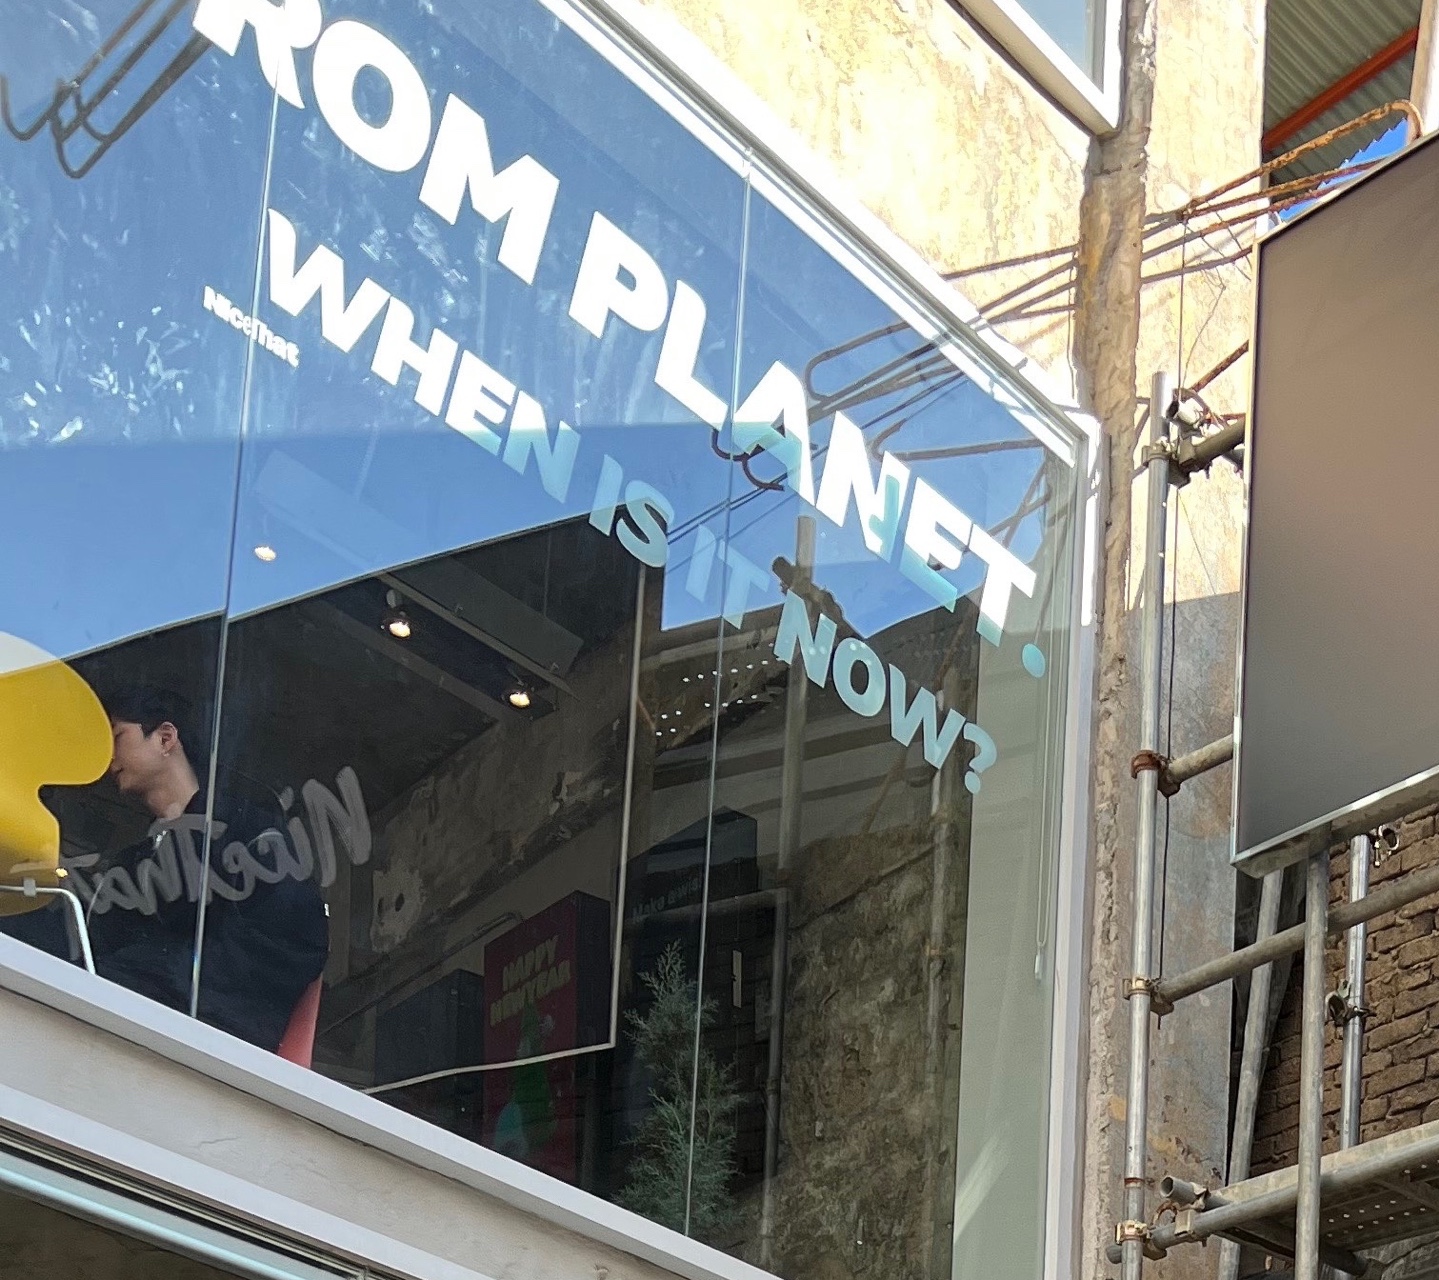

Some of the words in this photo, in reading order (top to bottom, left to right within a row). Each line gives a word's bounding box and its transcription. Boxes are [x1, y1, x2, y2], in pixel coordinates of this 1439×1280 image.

[267, 208, 582, 504] WHEN
[588, 454, 676, 568] IS
[685, 523, 770, 630] IT
[774, 589, 999, 795] NOW?
[568, 210, 1047, 677] PLANET.
[502, 934, 560, 992] HAPPY
